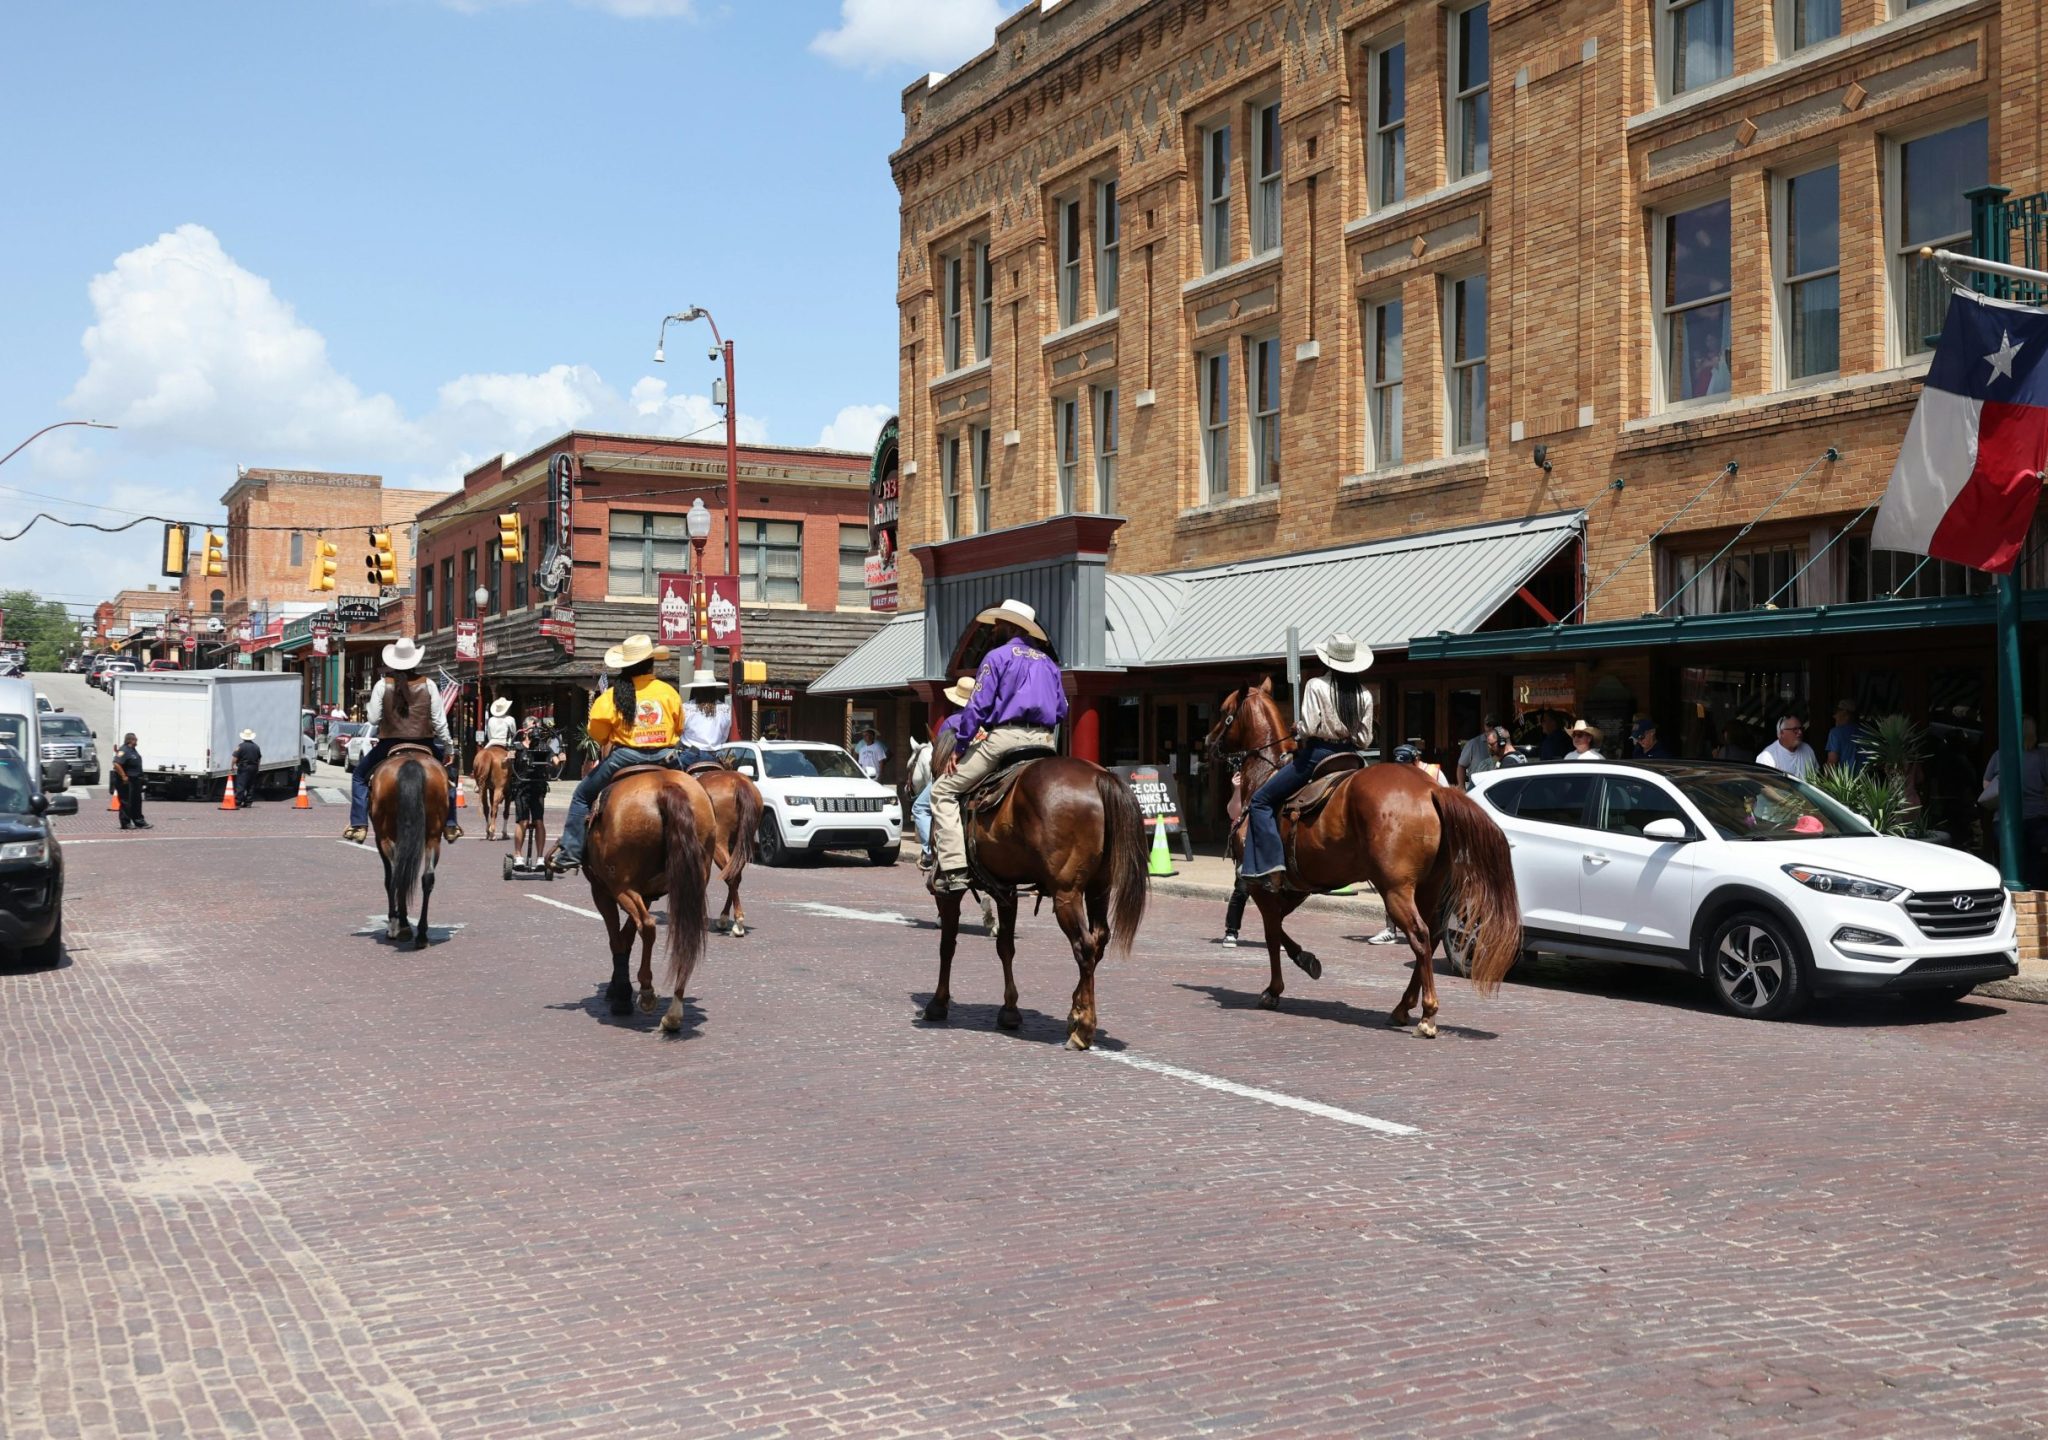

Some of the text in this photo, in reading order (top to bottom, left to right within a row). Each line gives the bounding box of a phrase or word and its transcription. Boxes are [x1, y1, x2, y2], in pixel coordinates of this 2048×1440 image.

[275, 473, 314, 485] BOARD
[883, 482, 896, 499] H3
[761, 689, 780, 700] Main
[1130, 783, 1167, 794] CE COLD
[1163, 792, 1170, 803] &
